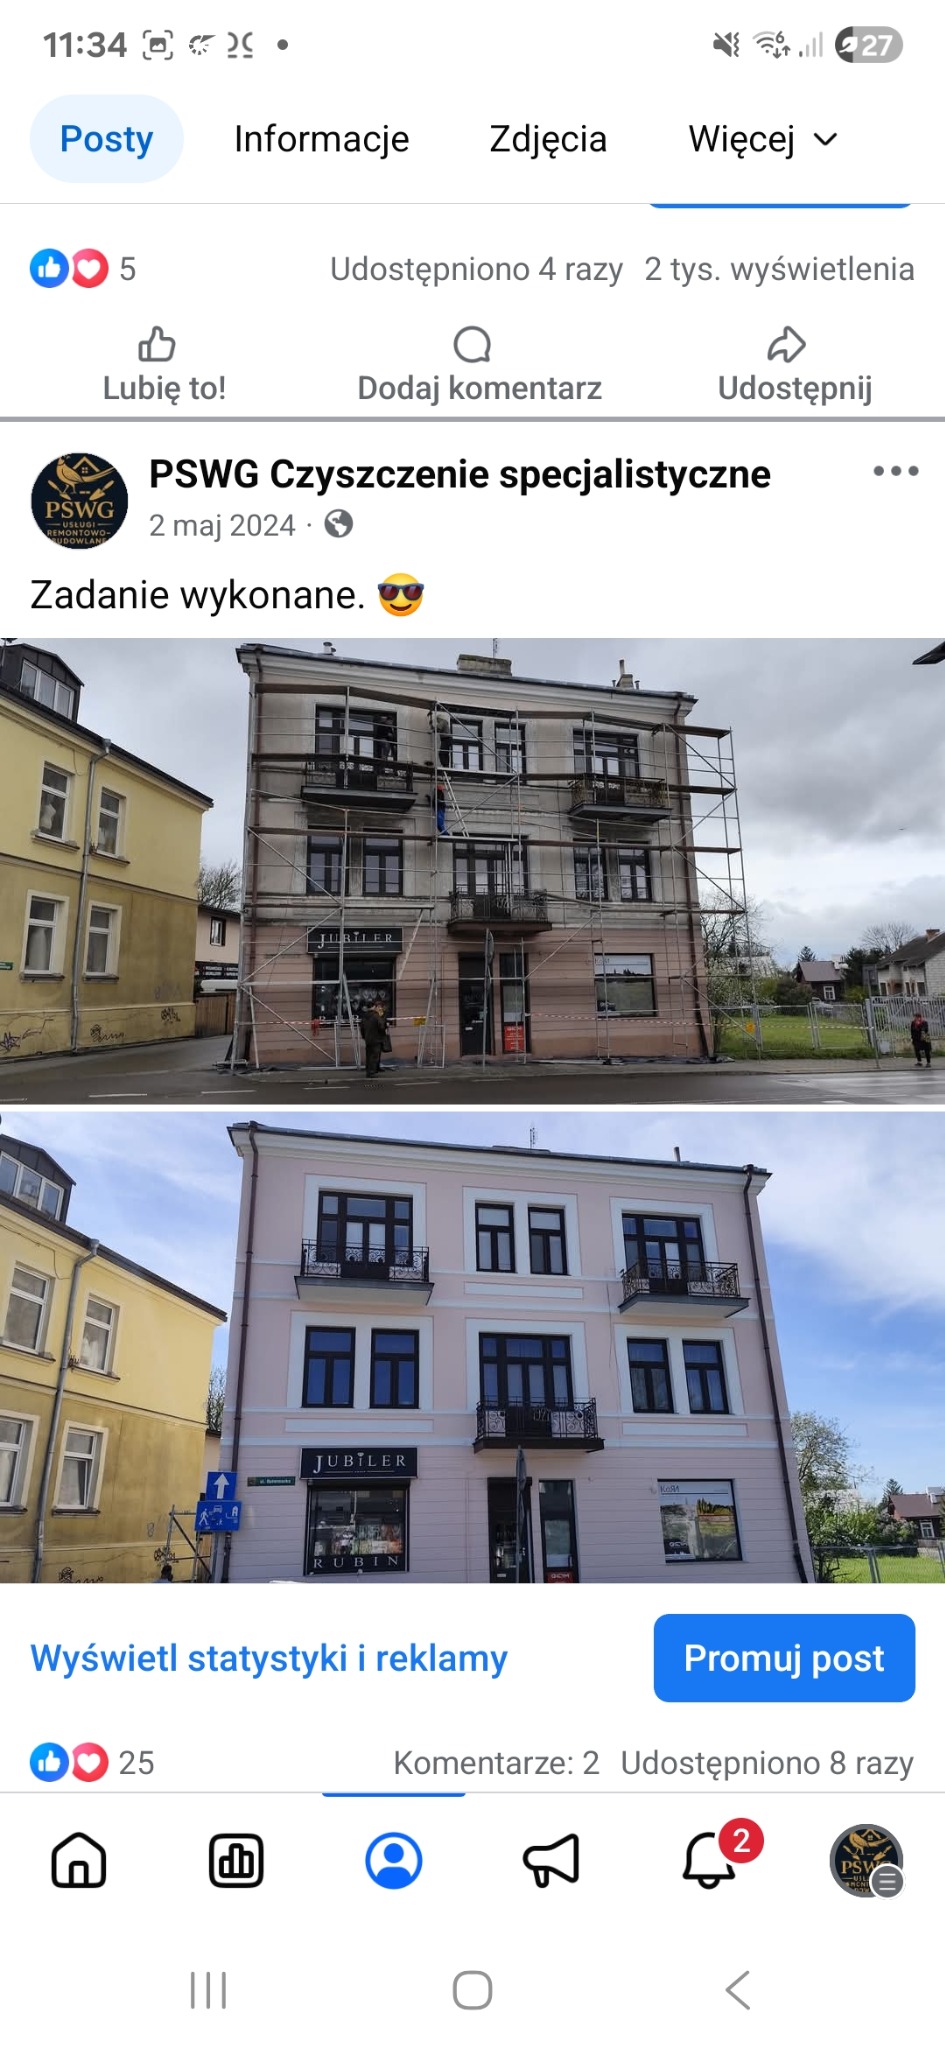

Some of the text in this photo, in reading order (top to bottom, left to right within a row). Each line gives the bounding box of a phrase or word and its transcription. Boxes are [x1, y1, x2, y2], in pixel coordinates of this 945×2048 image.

[43, 31, 127, 58] 11:34
[862, 35, 893, 56] 27
[61, 125, 154, 160] Posty
[236, 123, 409, 160] Informacje
[490, 123, 607, 160] Zdjęcia
[689, 125, 793, 160] Więcej
[120, 257, 136, 282] 5
[331, 255, 623, 287] Udostępniono 4 razy
[646, 255, 915, 287] 2 tys. wyświetlenia
[104, 374, 226, 406] Lubię to!
[358, 374, 602, 406] Dodaj komentarz
[719, 374, 872, 406] Udostępnij
[151, 457, 771, 496] PSWG Czyszczenie specjalistyczne
[45, 501, 114, 519] PSWG
[150, 514, 296, 542] 2 maj 2024
[31, 578, 365, 617] Zadanie wykonane.
[314, 1555, 399, 1569] RUBIN
[30, 1643, 508, 1679] Wyświetl statystyki i reklamy
[686, 1643, 884, 1679] Promuj post
[120, 1750, 154, 1775] 25
[395, 1750, 600, 1775] Komentarze: 2
[622, 1749, 915, 1781] Udostępniono 8 razy
[733, 1828, 751, 1853] 2
[841, 1860, 891, 1874] PSW
